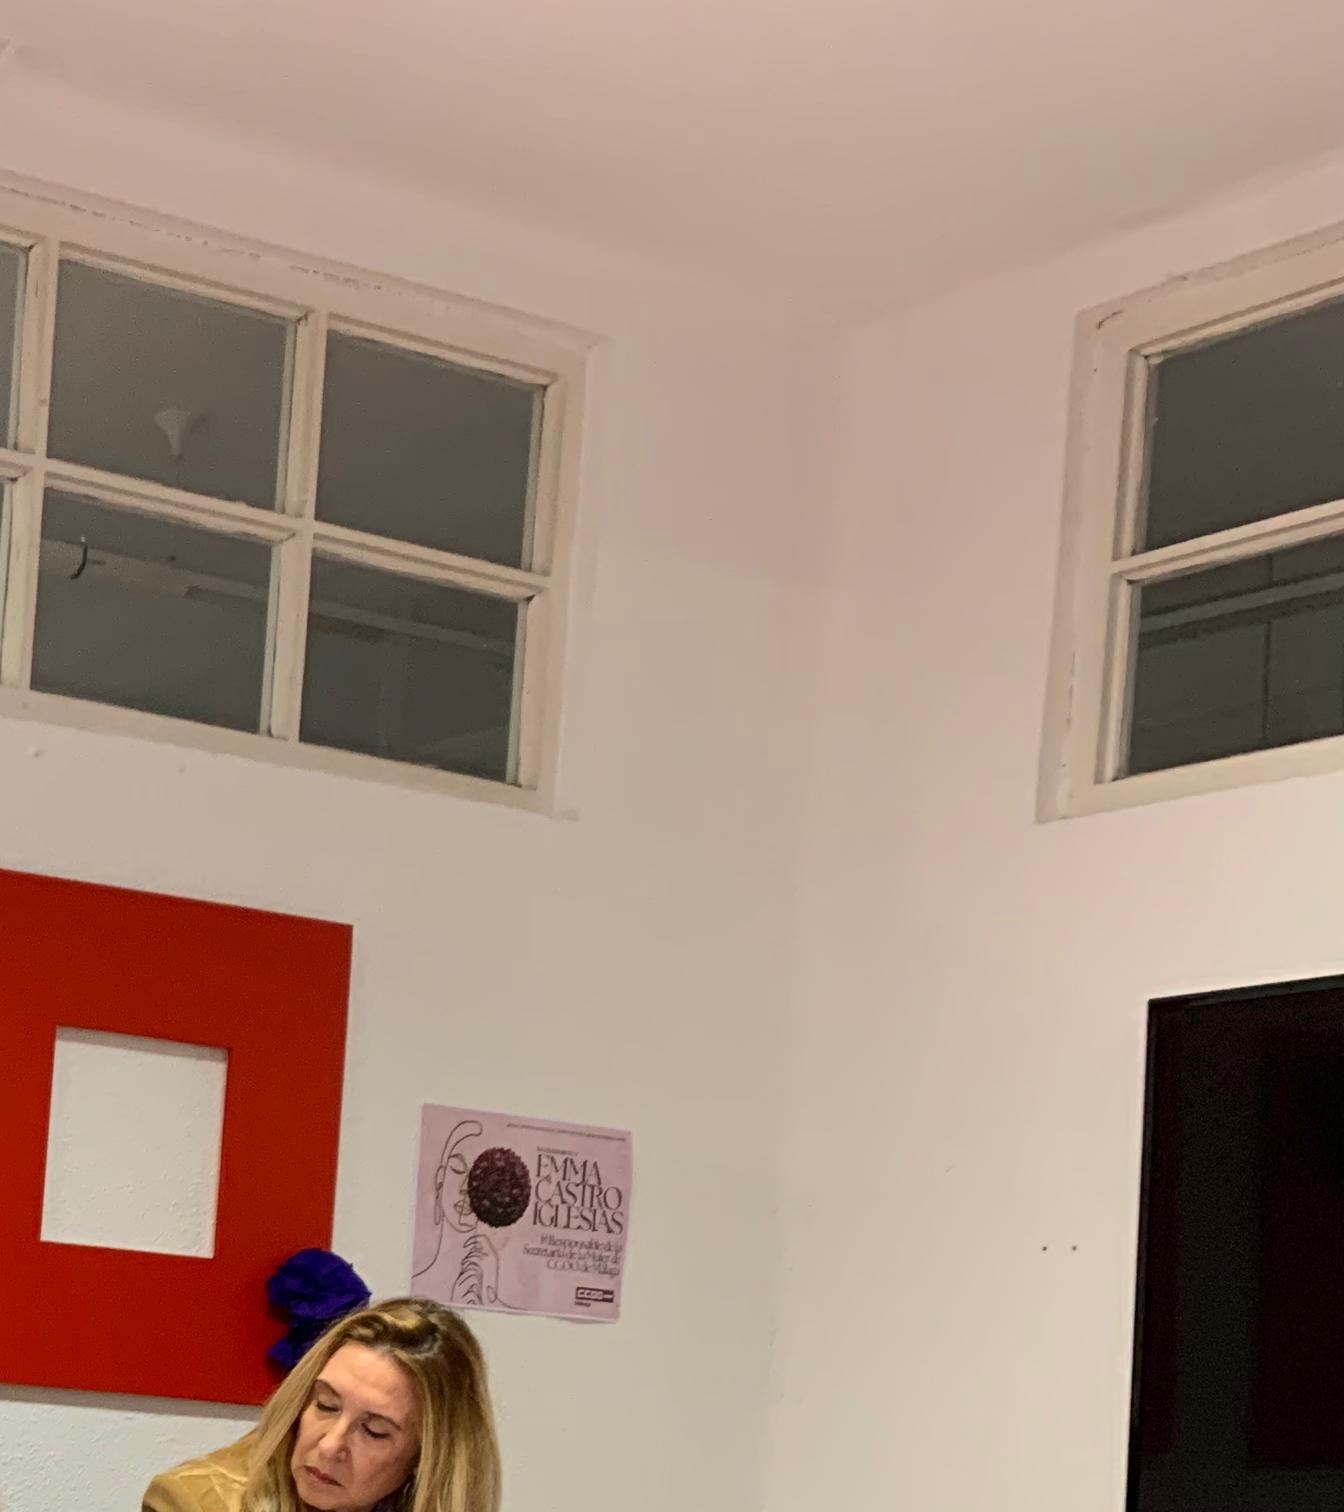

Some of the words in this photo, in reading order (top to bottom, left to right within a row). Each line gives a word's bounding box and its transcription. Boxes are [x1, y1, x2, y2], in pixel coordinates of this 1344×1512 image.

[536, 1153, 601, 1187] EMMA
[535, 1174, 622, 1210] CASTRO
[532, 1200, 623, 1235] IGLESIAS
